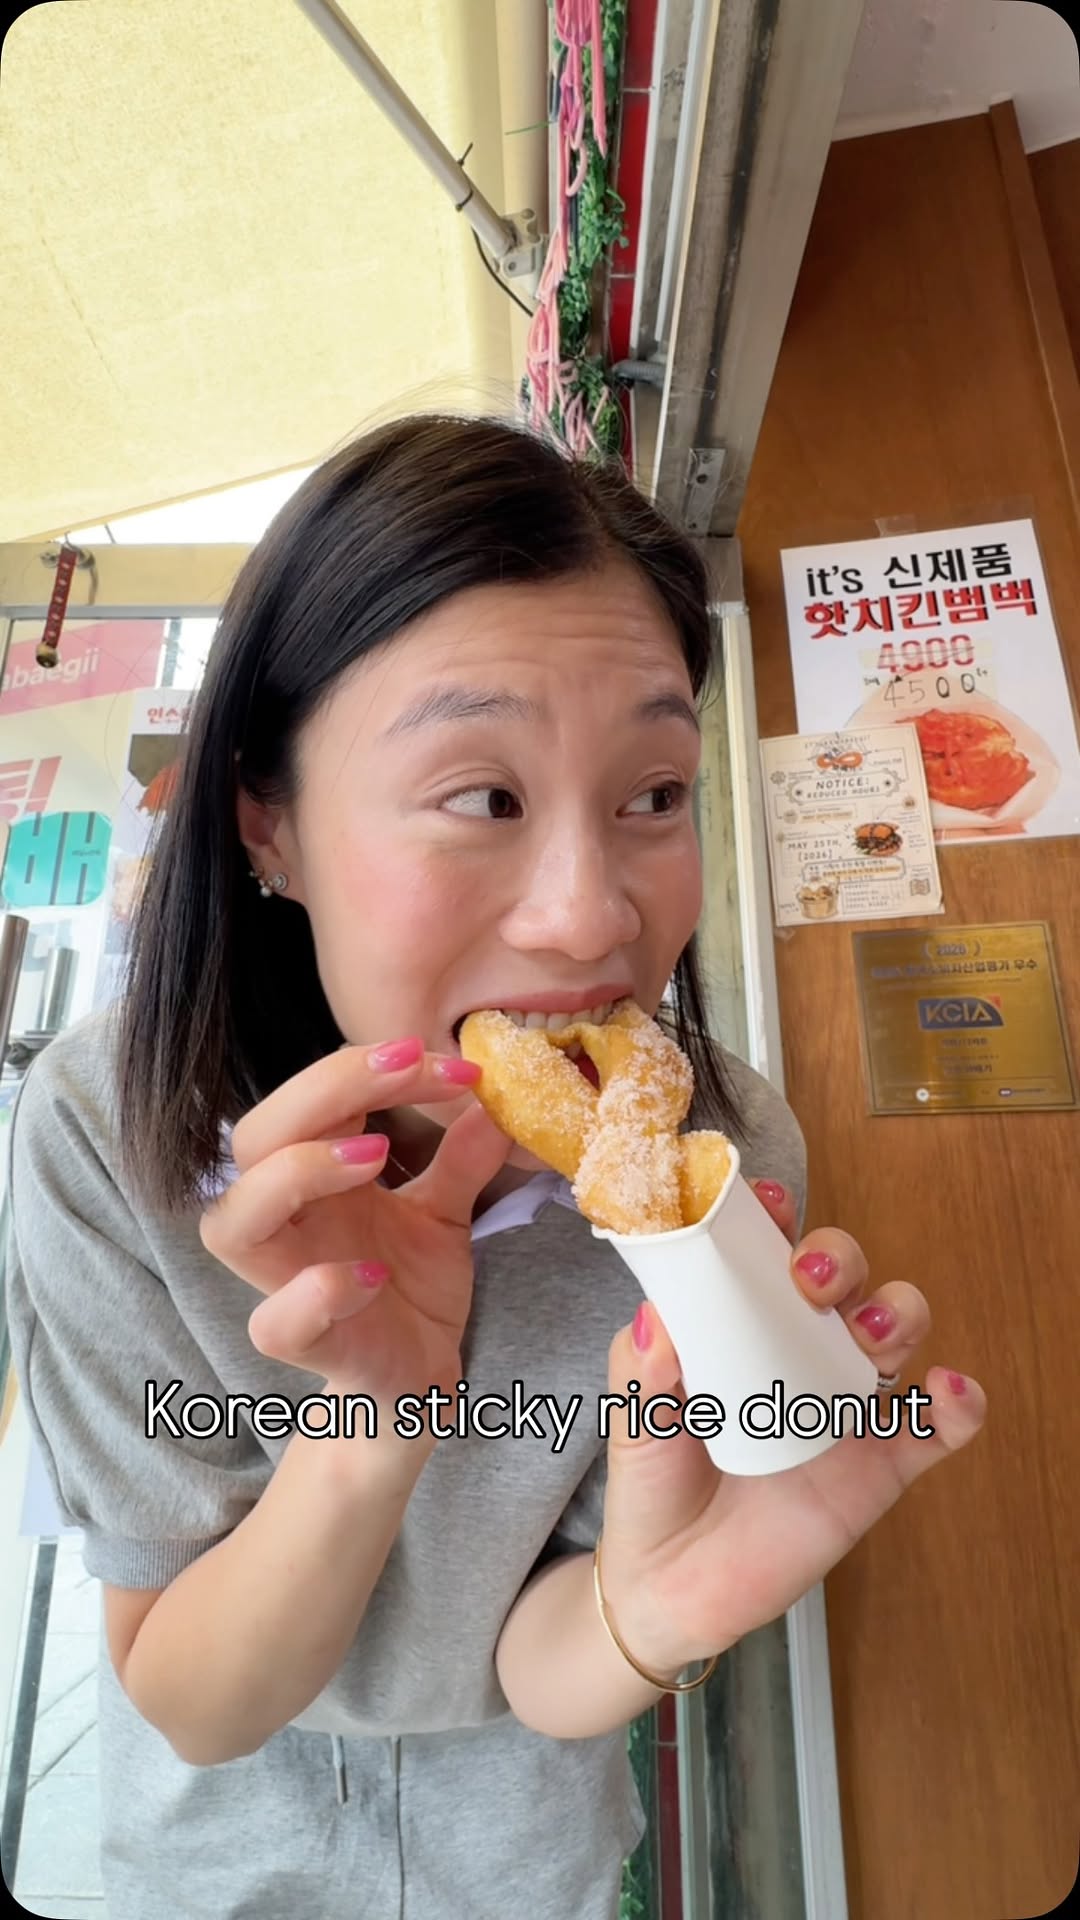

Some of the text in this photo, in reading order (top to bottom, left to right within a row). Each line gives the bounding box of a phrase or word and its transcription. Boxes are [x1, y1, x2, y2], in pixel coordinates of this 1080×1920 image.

[806, 543, 1013, 597] it's 신제품
[803, 578, 1039, 640] 핫치킨범벅
[883, 672, 976, 708] 4500
[815, 776, 870, 790] NOTICE:
[925, 1002, 995, 1025] KCIA
